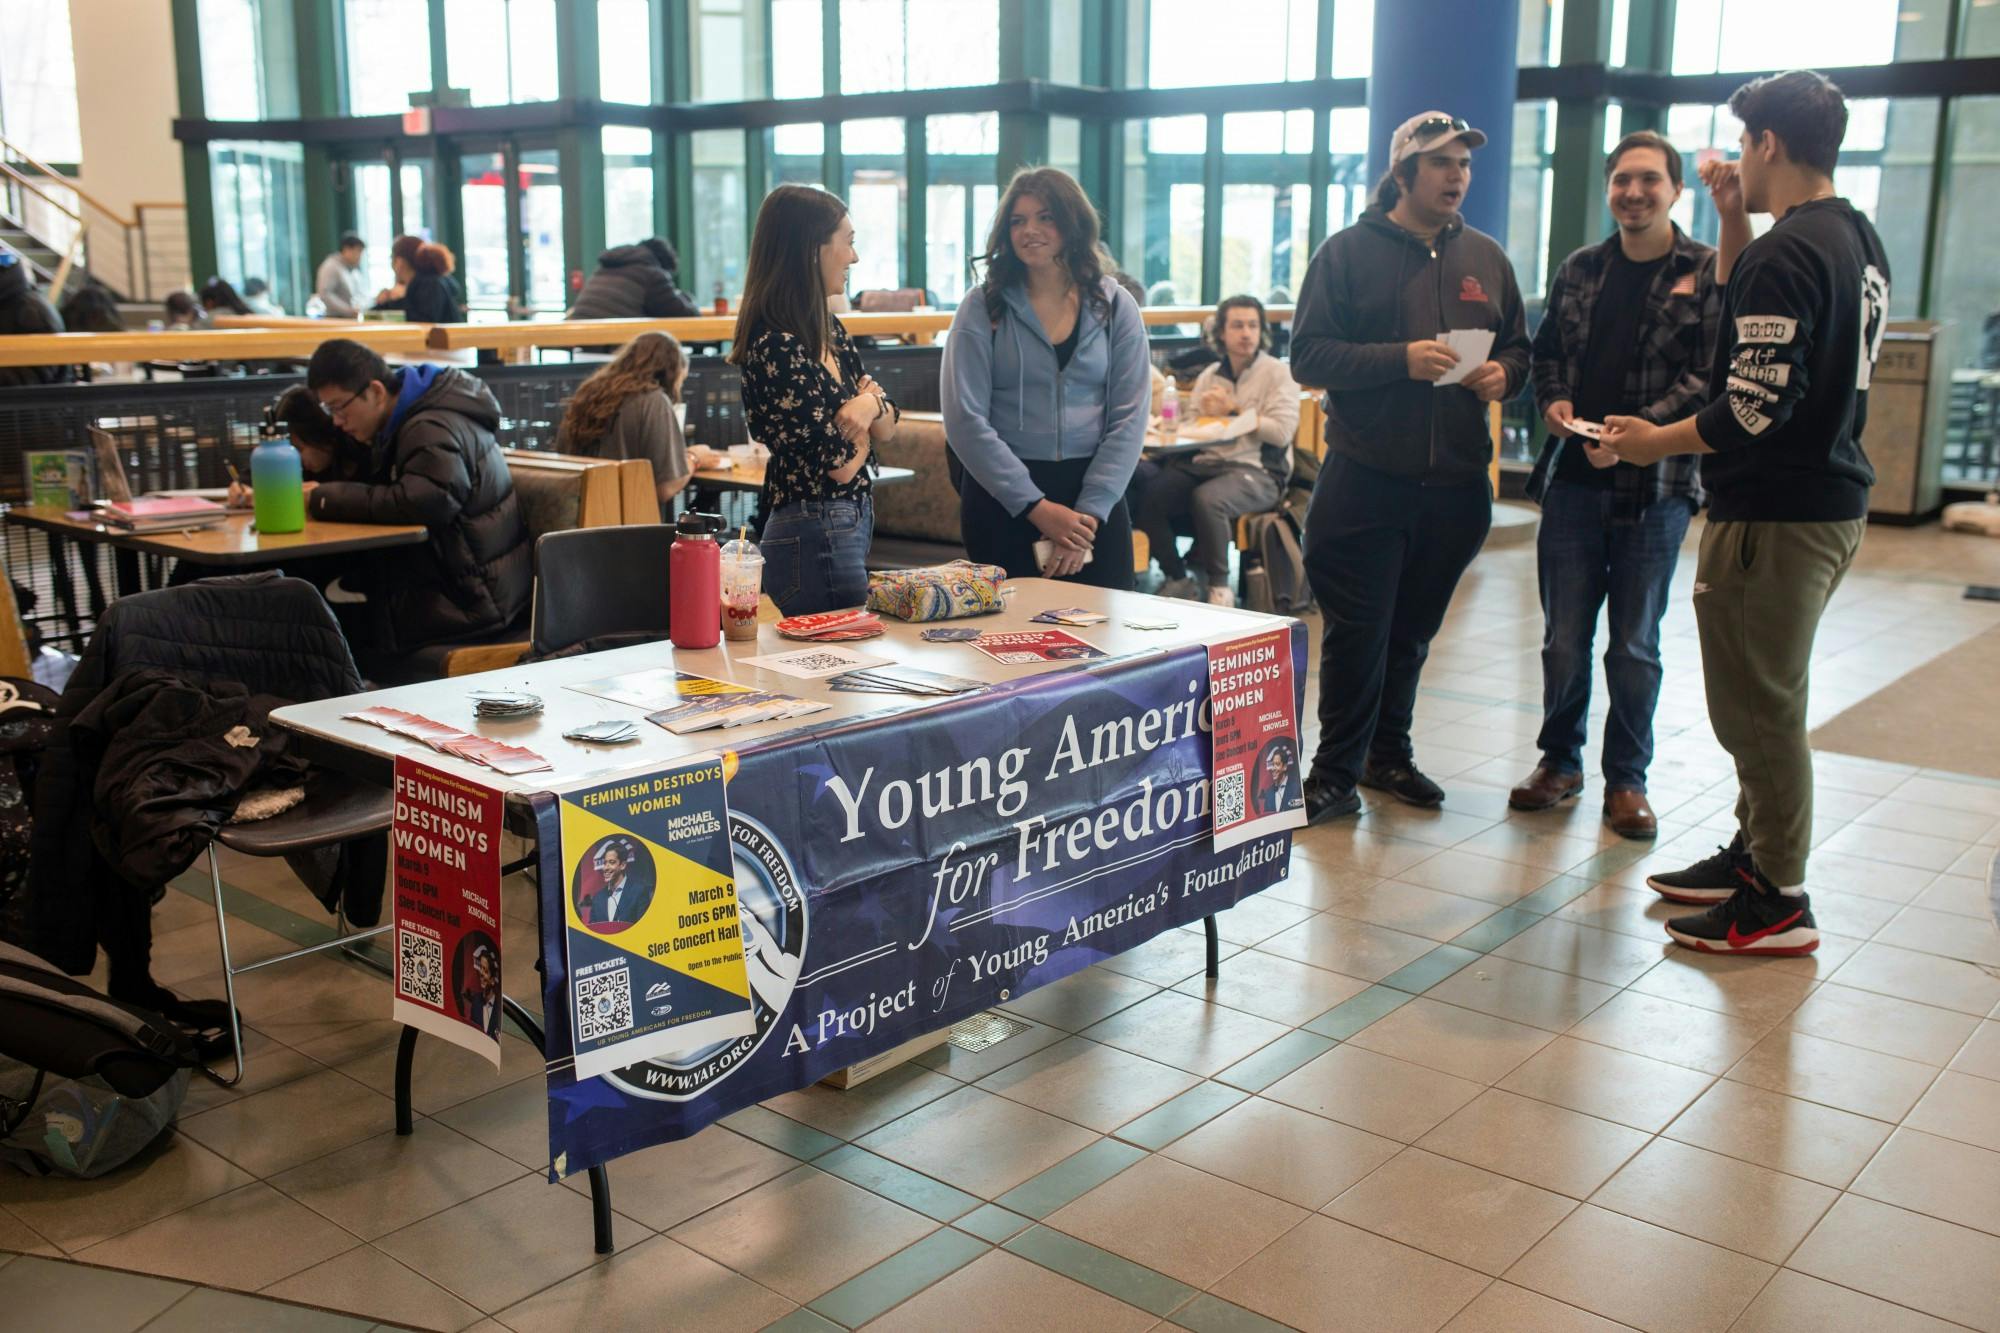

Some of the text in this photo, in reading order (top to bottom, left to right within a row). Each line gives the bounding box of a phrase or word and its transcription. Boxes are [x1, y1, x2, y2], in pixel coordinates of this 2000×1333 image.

[1210, 645, 1275, 675] FEMINISM
[1211, 664, 1280, 696] DESTROYS
[1213, 688, 1264, 716] WOMEN
[1258, 710, 1283, 723] MICHAEL
[1262, 719, 1289, 733] KNOWLES
[825, 680, 1212, 843] Young Americ
[396, 774, 483, 824] FEMINISM
[583, 766, 722, 808] FEMINISM DESTROYS
[628, 793, 681, 816] WOMEN
[396, 801, 488, 853] DESTROYS
[668, 810, 715, 830] MICHAEL
[668, 821, 721, 842] KNOWLES
[395, 828, 467, 871] WOMEN
[732, 825, 800, 913] FOR FREEDOM
[462, 887, 490, 910] MICHAEL
[689, 883, 734, 905] March 9
[907, 840, 998, 951] for
[401, 919, 441, 940] FREE TICKETS:
[467, 904, 497, 929] KNOWLES
[678, 904, 737, 929] Doors 6PM
[647, 924, 739, 958] Slee Concert Hall
[782, 836, 1286, 1058] A Project of Young America's Foundation
[575, 956, 627, 978] FREE TICKETS:
[688, 952, 742, 971] Open to the Public
[608, 1031, 630, 1042] YOUNG
[631, 1021, 667, 1035] AMERICANS
[667, 1017, 681, 1026] FOR
[681, 1009, 712, 1022] FREEDOM
[645, 1035, 754, 1090] WWW.YAF.ORG
